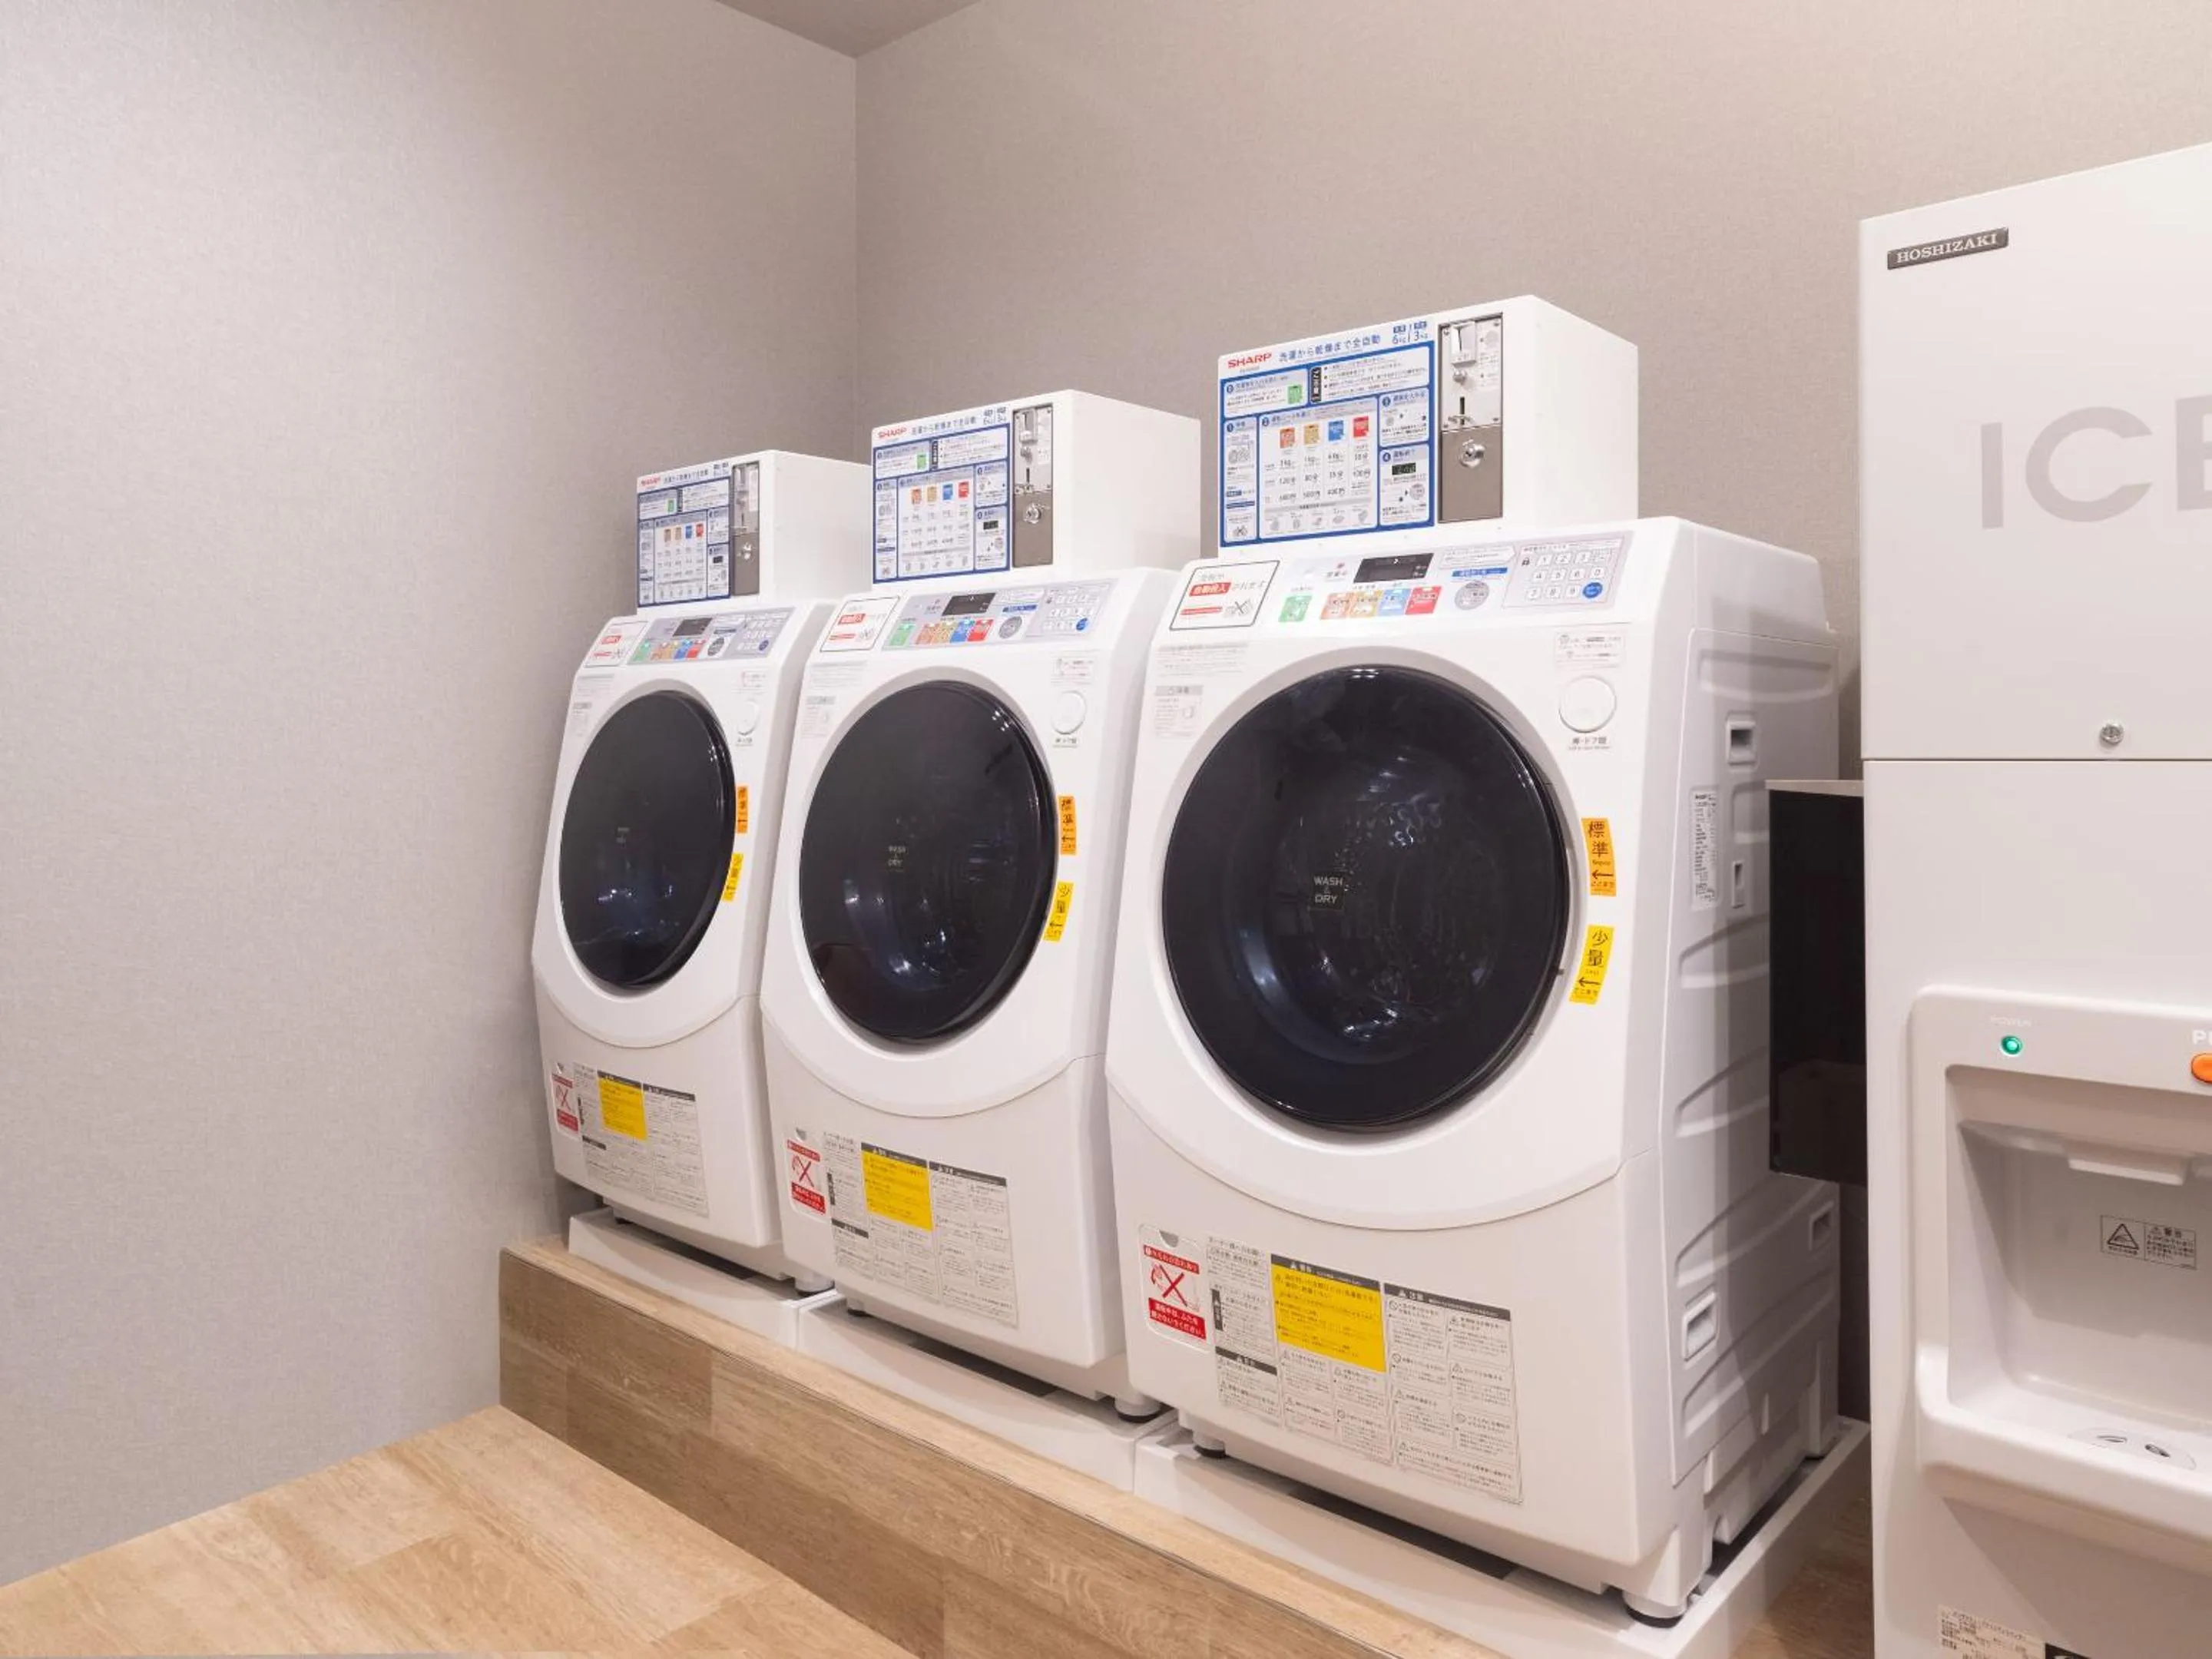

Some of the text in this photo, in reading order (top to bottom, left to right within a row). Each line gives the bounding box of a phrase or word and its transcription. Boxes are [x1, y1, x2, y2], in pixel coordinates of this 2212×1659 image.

[1895, 233, 1997, 263] HOSHIZAKI
[1227, 352, 1272, 369] SHARP
[1981, 394, 2212, 529] ICE
[1588, 820, 1608, 857] 標準
[1313, 876, 1343, 886] WASH
[1314, 893, 1337, 905] DRY
[1588, 930, 1608, 967] 少量
